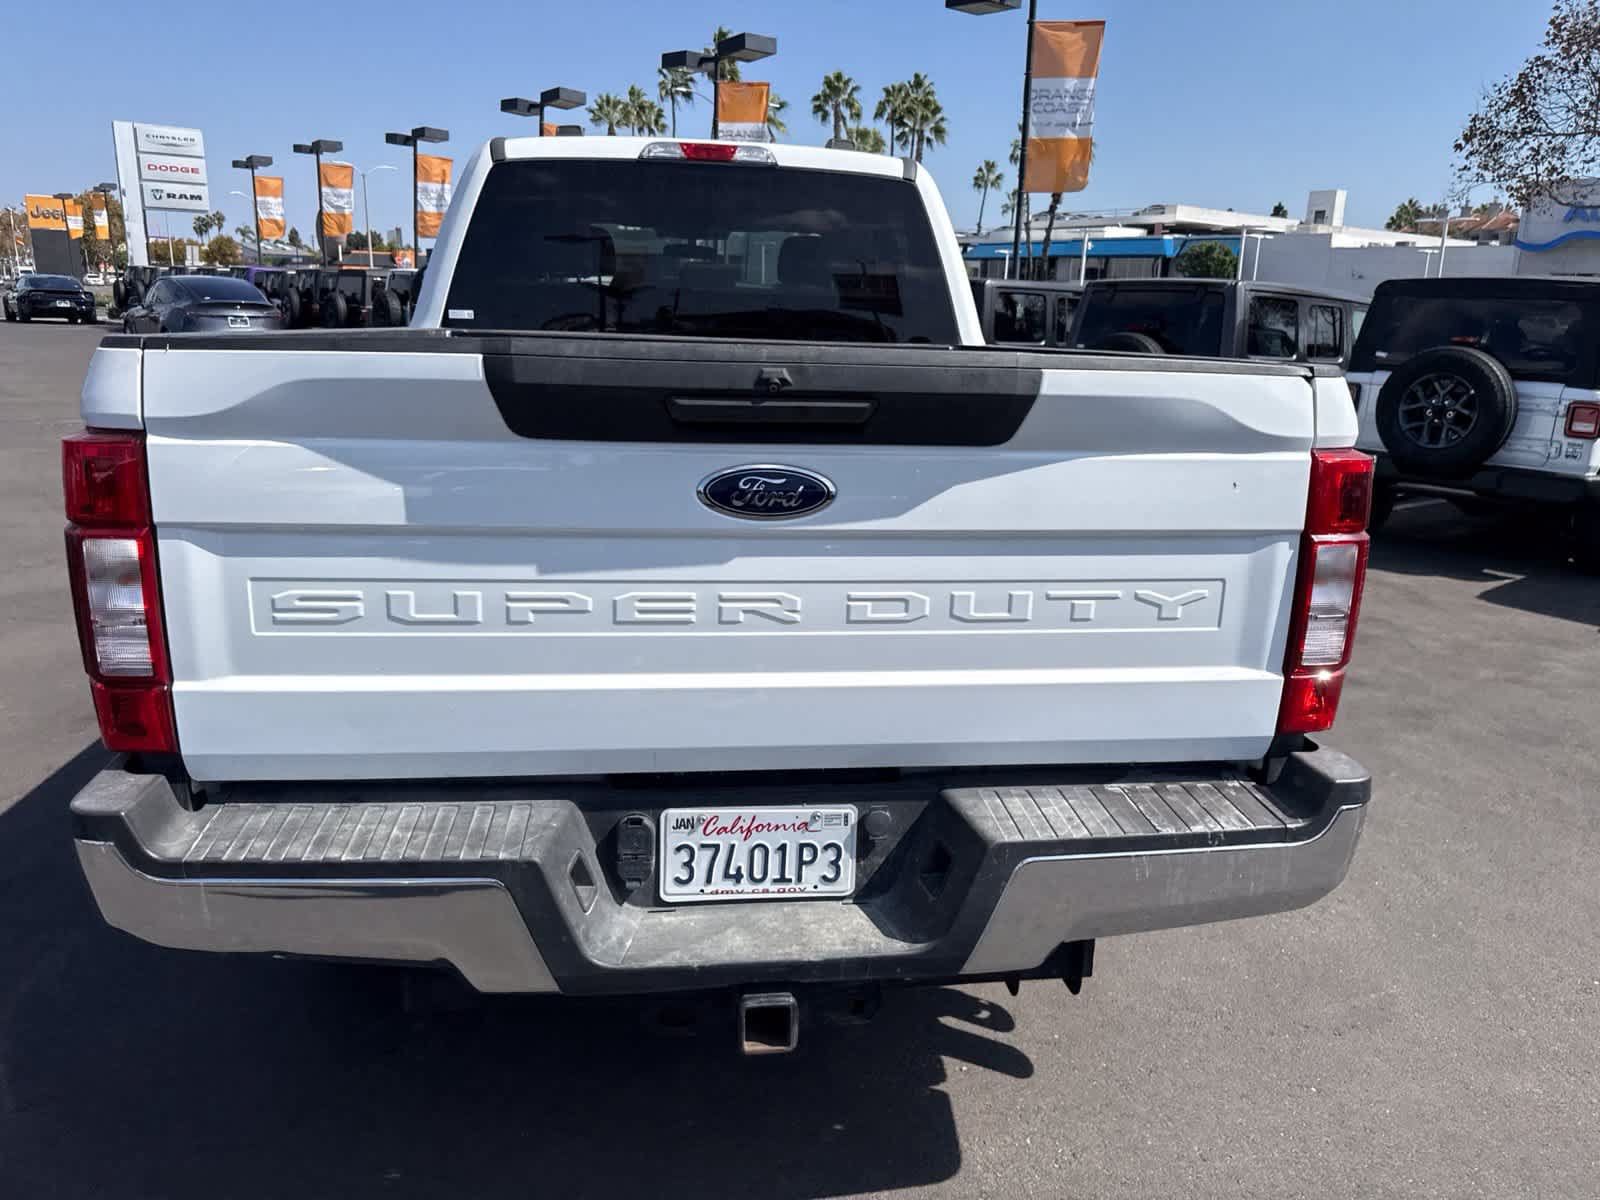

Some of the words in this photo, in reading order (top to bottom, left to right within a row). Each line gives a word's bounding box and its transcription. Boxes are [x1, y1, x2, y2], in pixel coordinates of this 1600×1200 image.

[147, 163, 200, 175] DODGE
[166, 192, 202, 201] RAM
[730, 476, 804, 507] Ford
[271, 590, 802, 625] SUPER
[845, 589, 1209, 625] DUTY
[672, 816, 696, 830] JAN
[702, 815, 822, 842] California
[673, 841, 844, 886] 37401P3
